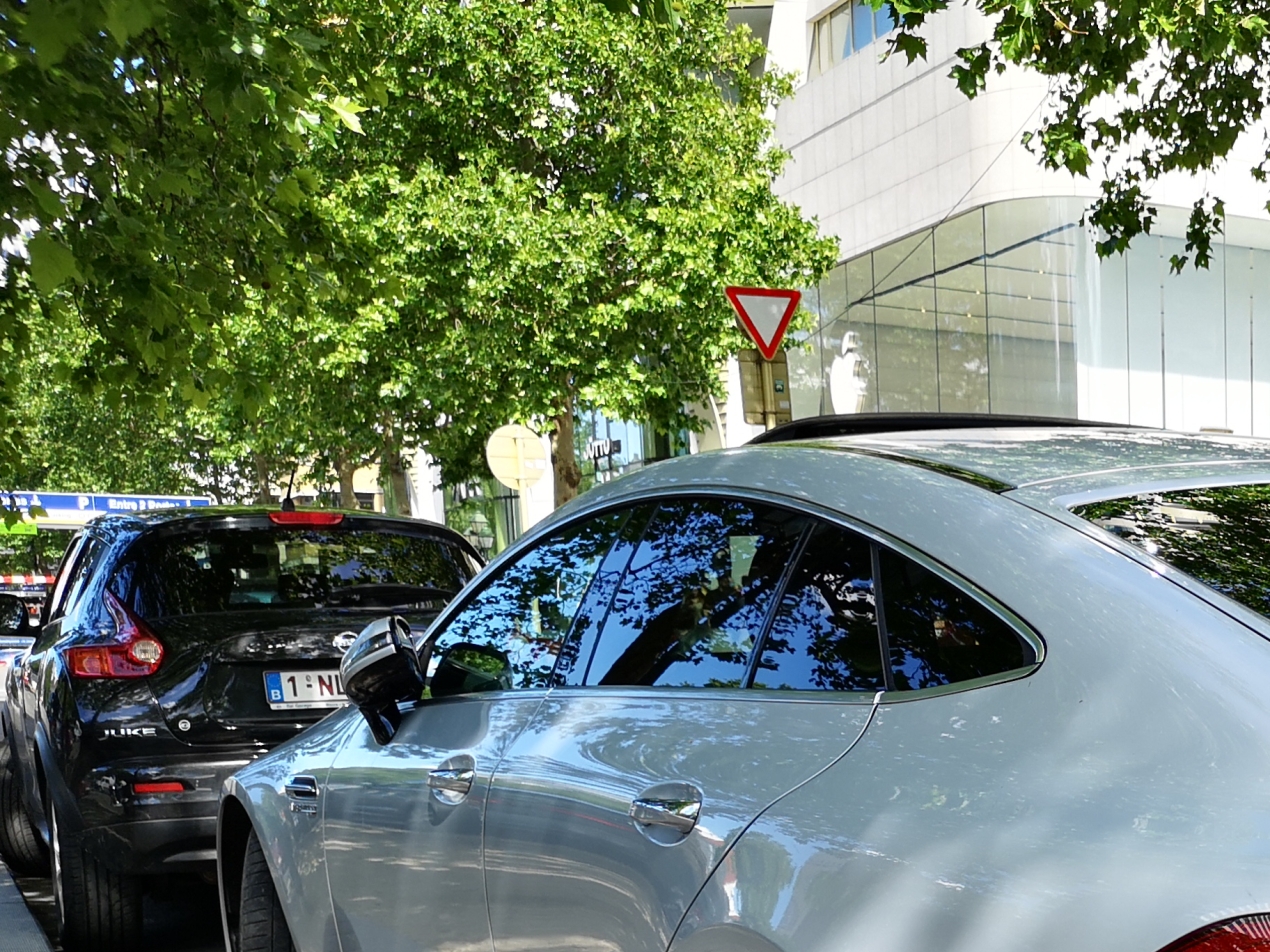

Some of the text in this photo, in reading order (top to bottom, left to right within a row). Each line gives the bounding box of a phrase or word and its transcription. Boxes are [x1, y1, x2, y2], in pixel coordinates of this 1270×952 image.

[108, 498, 138, 511] Entre
[271, 690, 281, 700] B
[99, 727, 157, 741] JUKE
